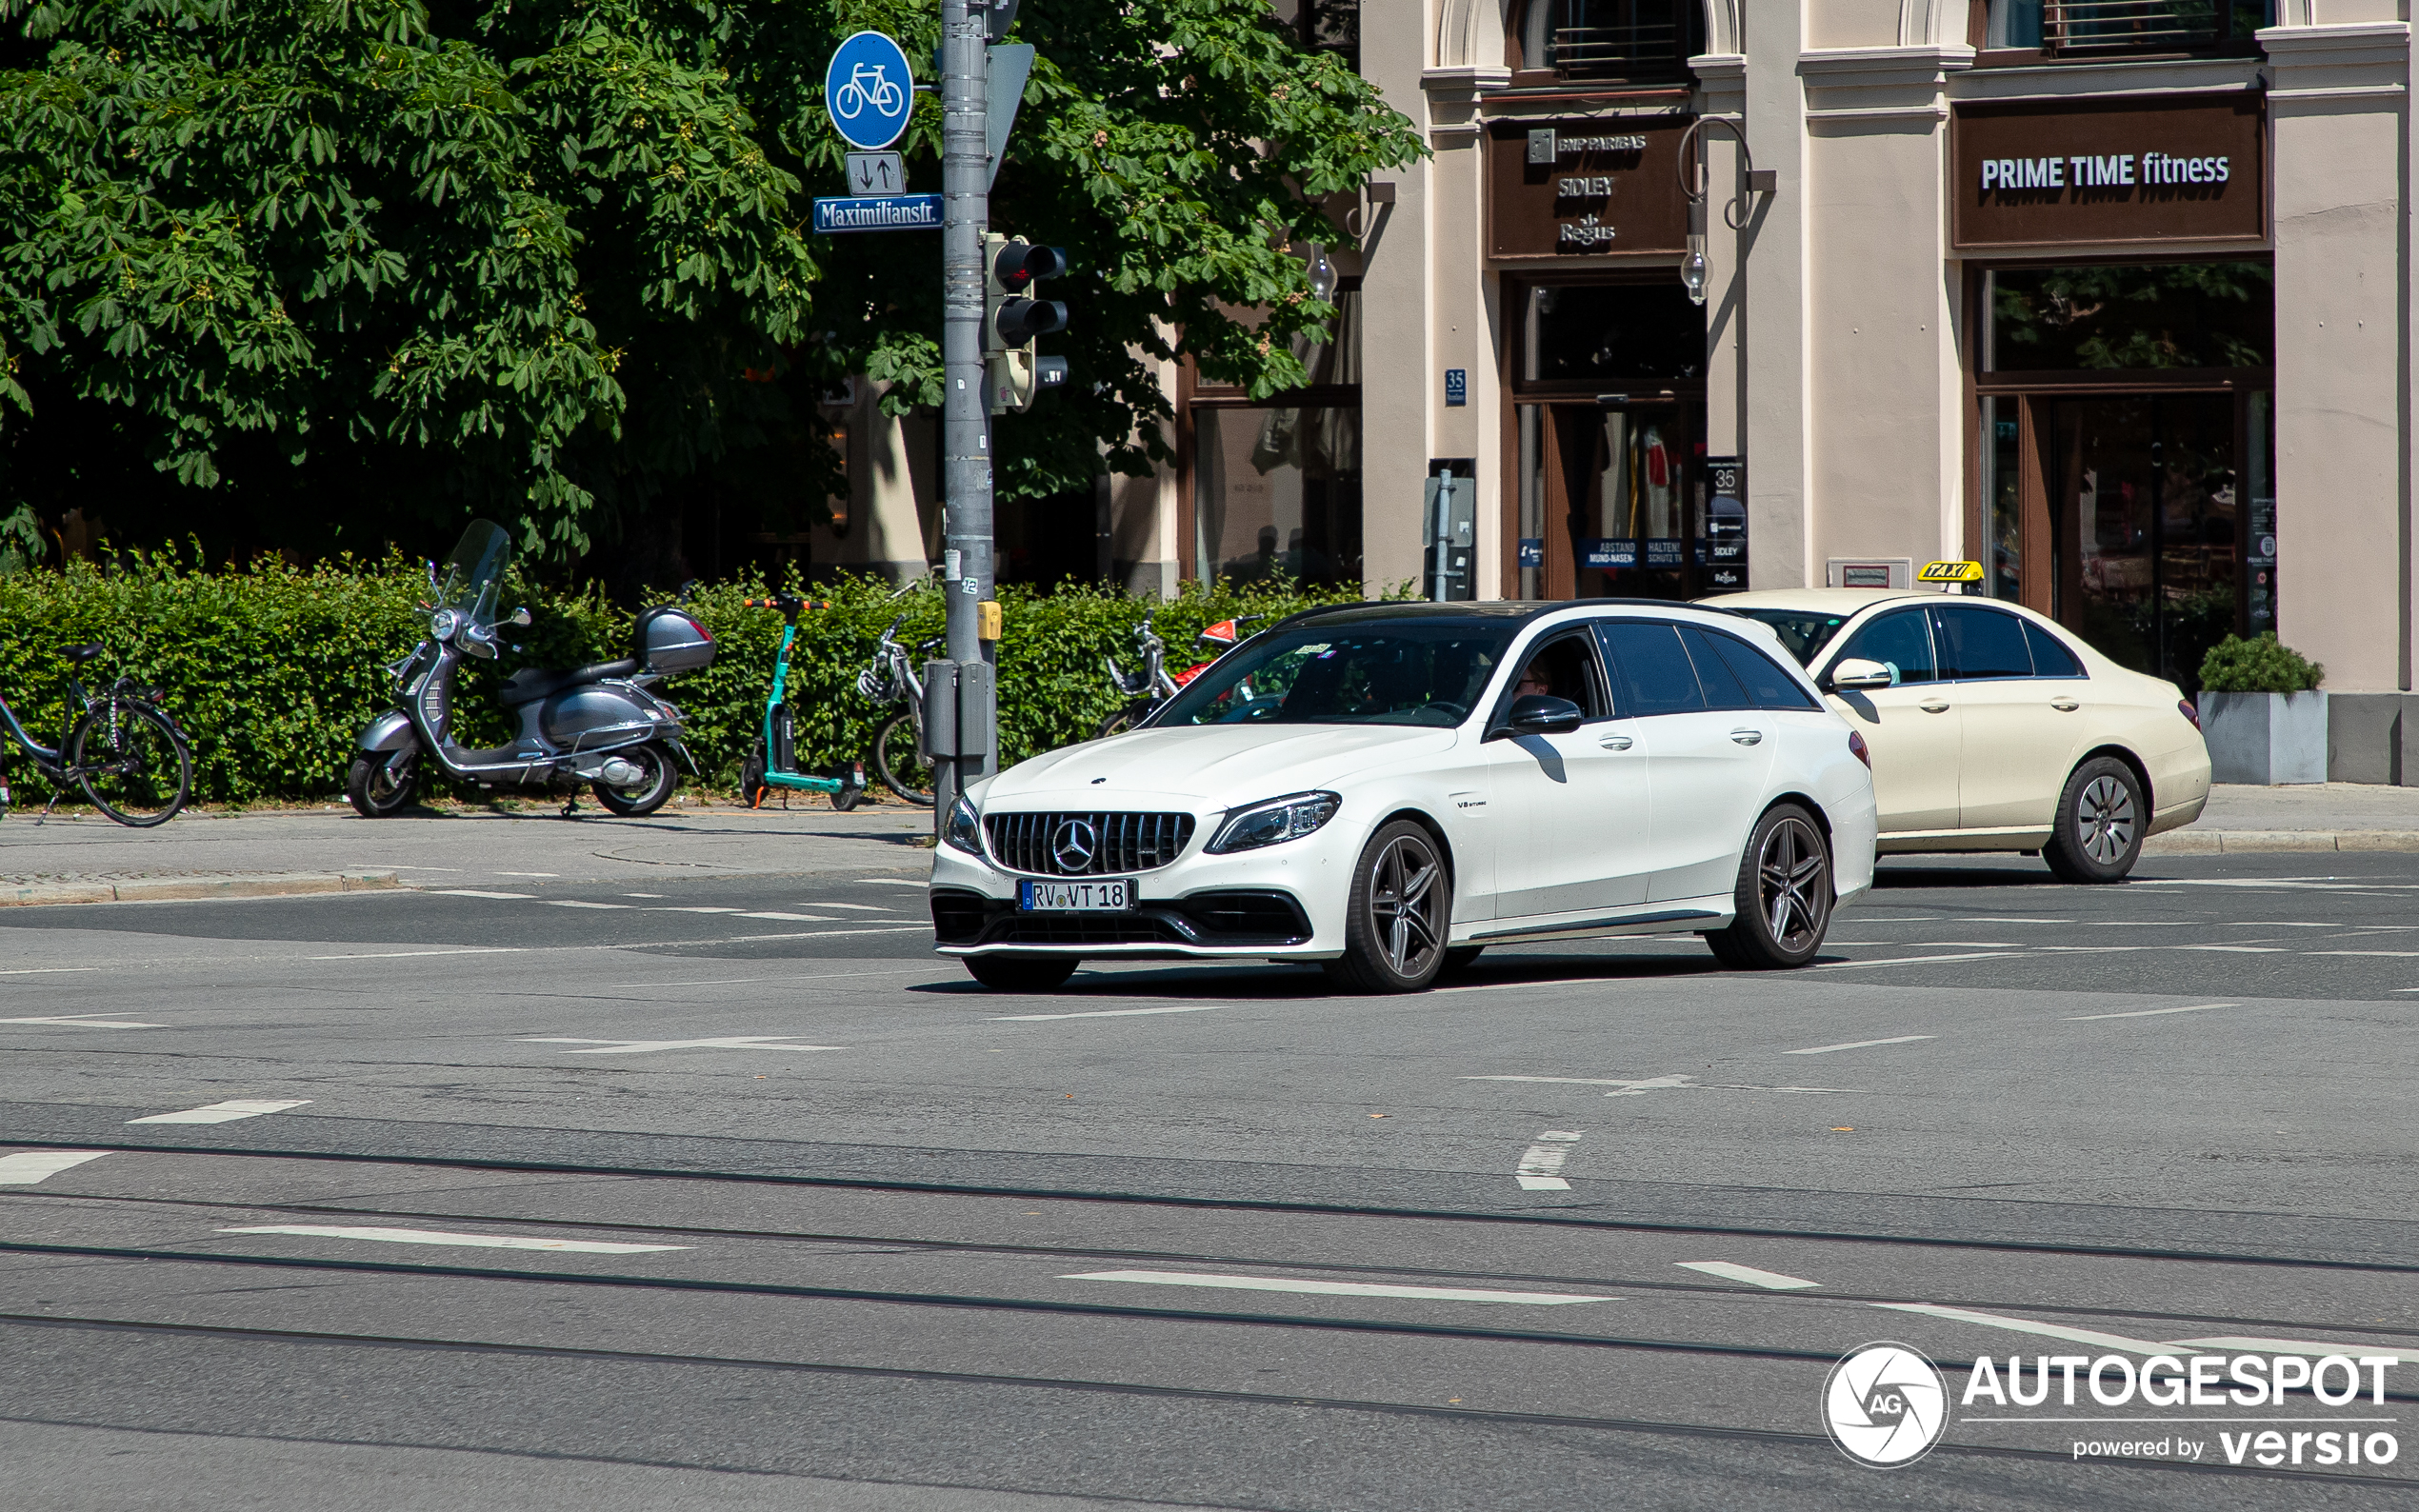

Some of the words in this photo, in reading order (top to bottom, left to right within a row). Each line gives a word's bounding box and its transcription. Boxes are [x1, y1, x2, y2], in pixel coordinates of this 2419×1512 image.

[1558, 138, 1588, 151] BNP
[1589, 135, 1647, 150] PARIBAS
[1982, 156, 2065, 189] PRIME
[2070, 154, 2135, 186] TIME
[2143, 152, 2230, 184] fitness
[1558, 176, 1614, 197] SIDLEY
[821, 201, 936, 227] Maximilianstr.
[1560, 223, 1616, 246] Regus
[1448, 371, 1464, 388] 35
[1715, 469, 1735, 487] 35
[1600, 542, 1636, 552] ABSTAND
[1928, 564, 1969, 577] TAXI
[1033, 885, 1056, 907] RV
[1068, 885, 1093, 907] VT
[1098, 885, 1124, 907] 18
